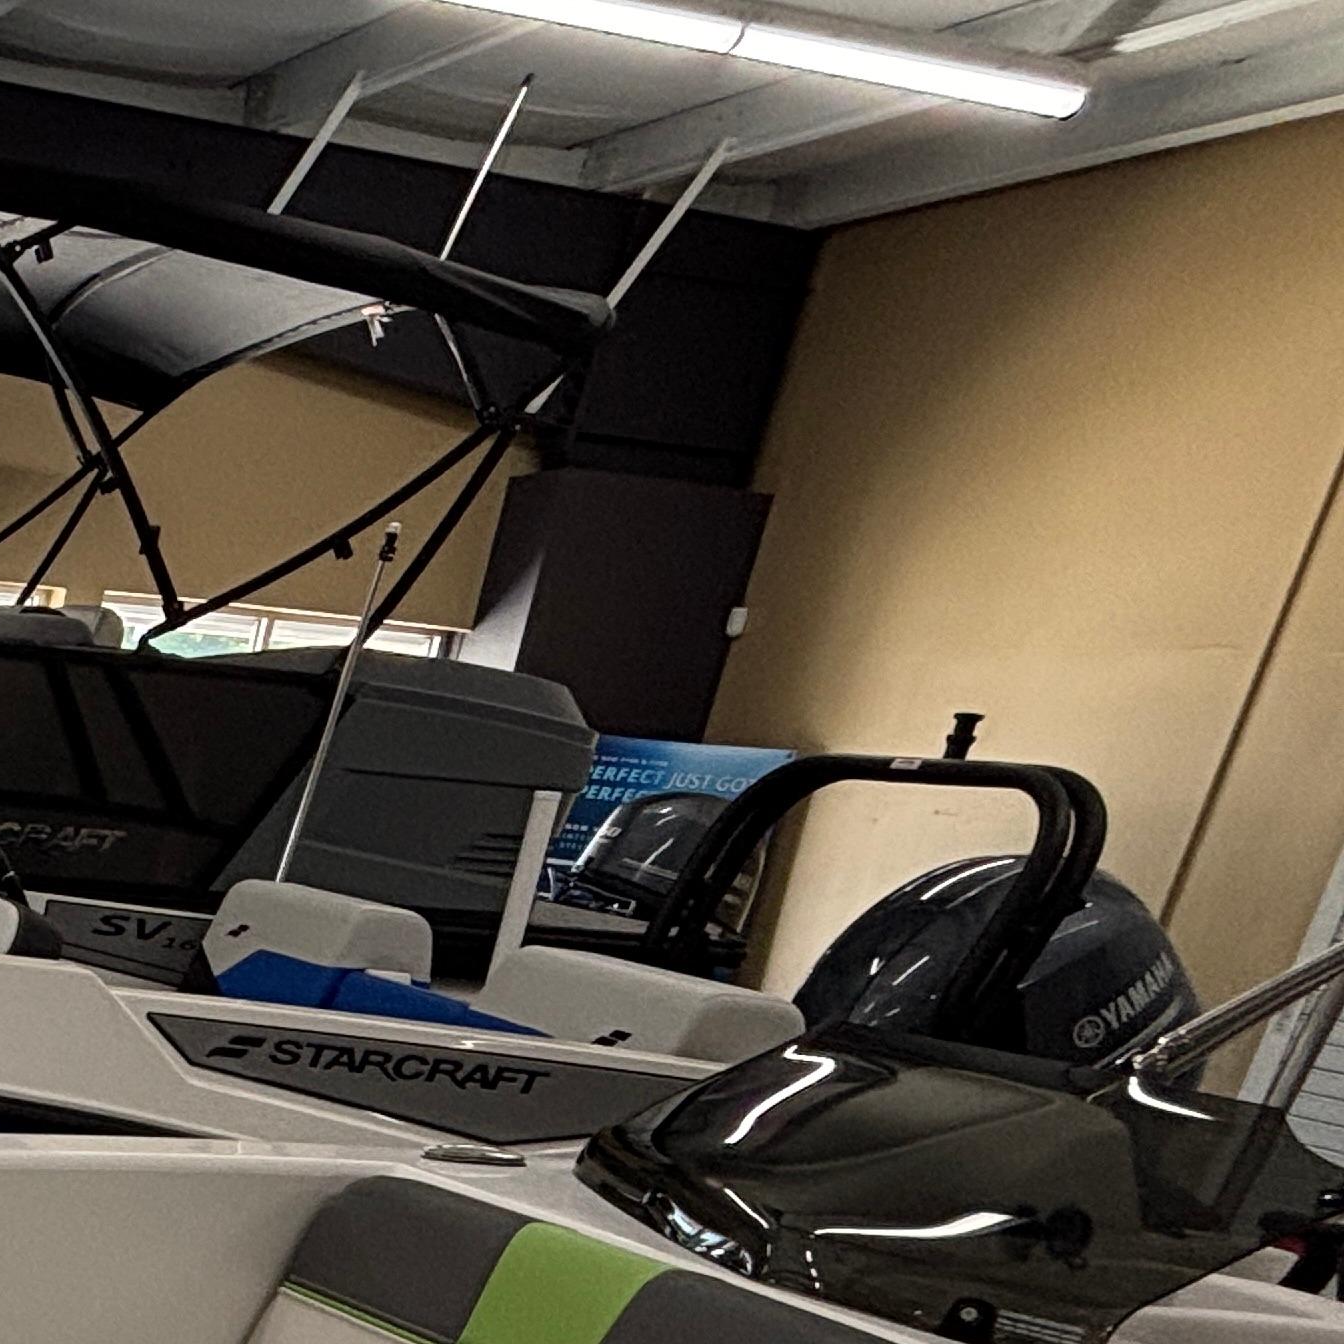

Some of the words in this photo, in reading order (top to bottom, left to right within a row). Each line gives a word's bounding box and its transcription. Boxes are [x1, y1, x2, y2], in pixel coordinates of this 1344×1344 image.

[589, 765, 665, 785] ERFECT
[662, 772, 714, 790] JUST
[580, 784, 647, 802] ERFE
[91, 914, 172, 941] SV
[268, 1039, 551, 1095] STARCRAFT
